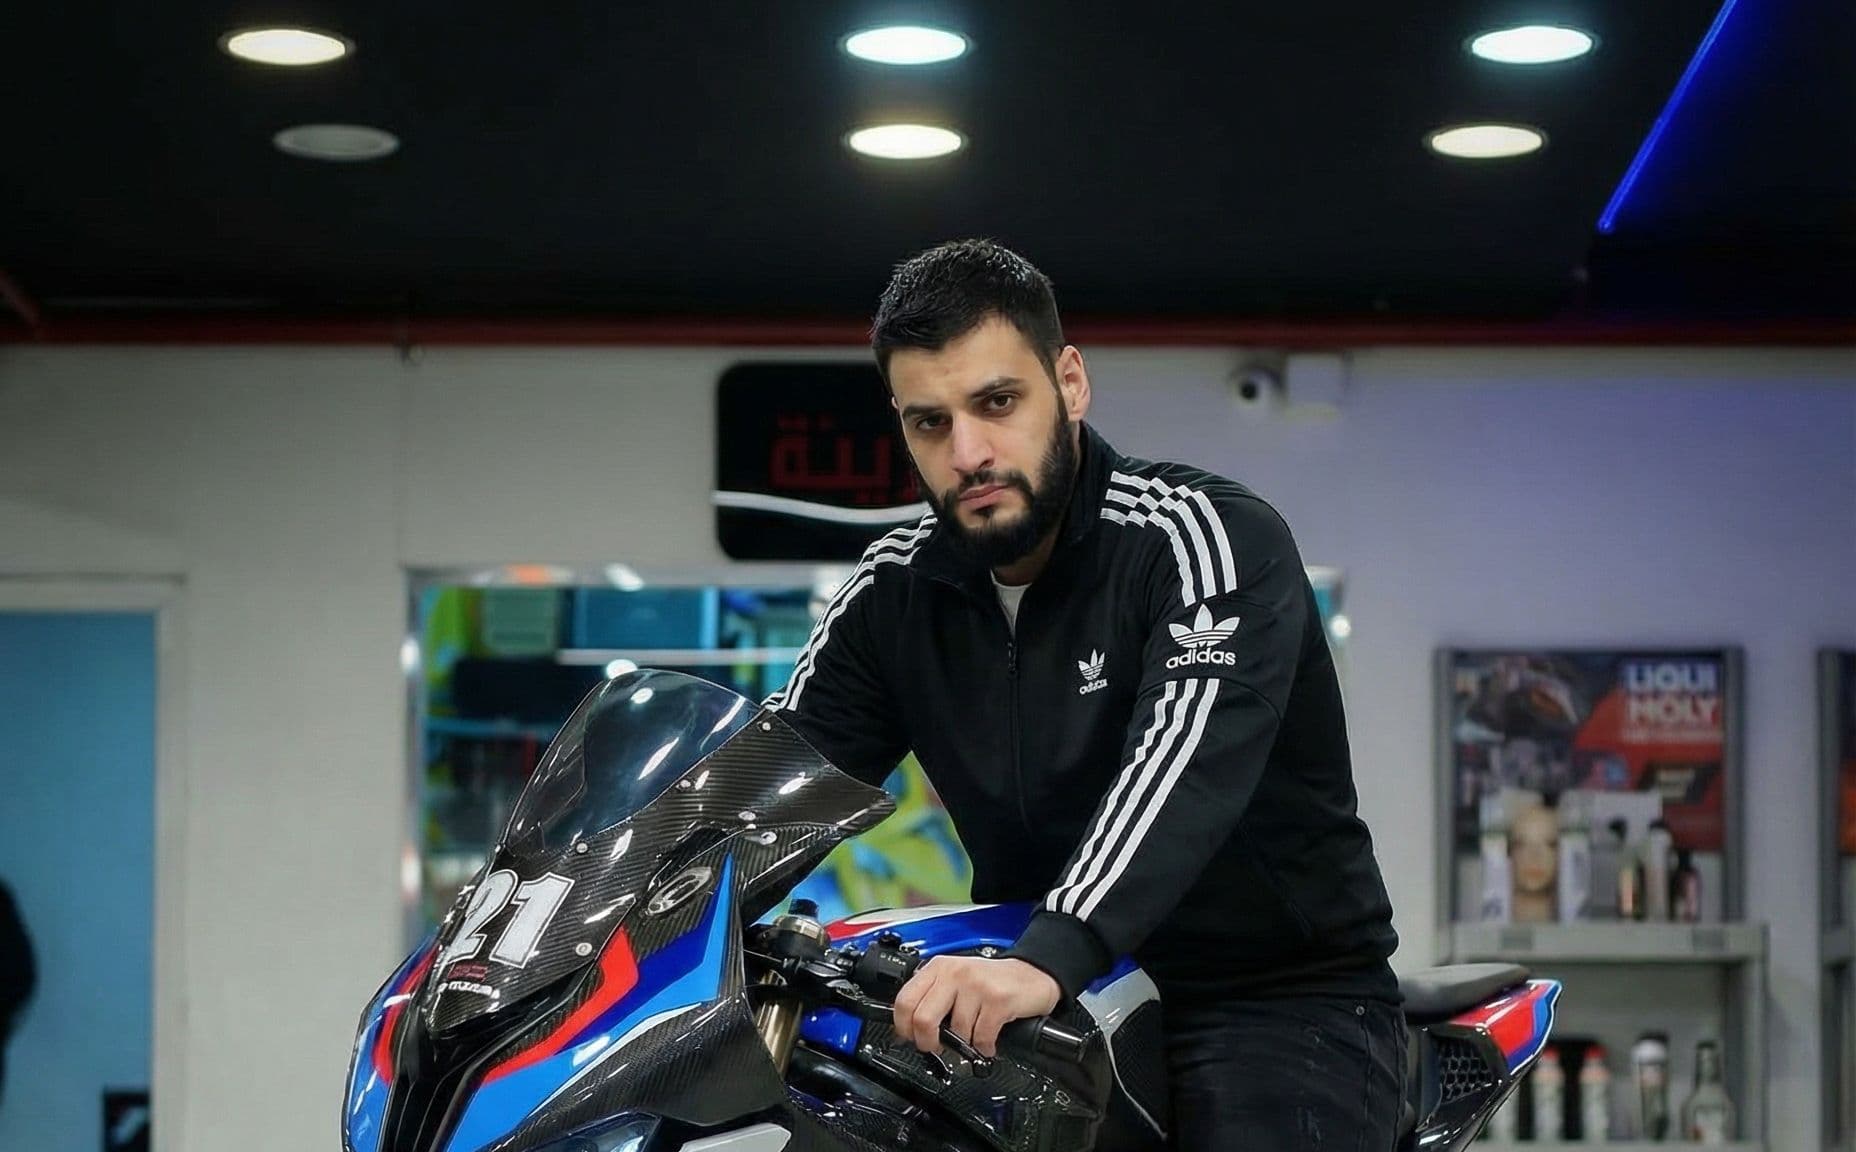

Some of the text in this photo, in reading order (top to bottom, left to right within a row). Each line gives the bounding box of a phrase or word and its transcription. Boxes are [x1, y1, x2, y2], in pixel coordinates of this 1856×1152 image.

[1165, 647, 1237, 669] adidas
[1626, 694, 1721, 722] MOLY
[446, 869, 575, 969] 21
